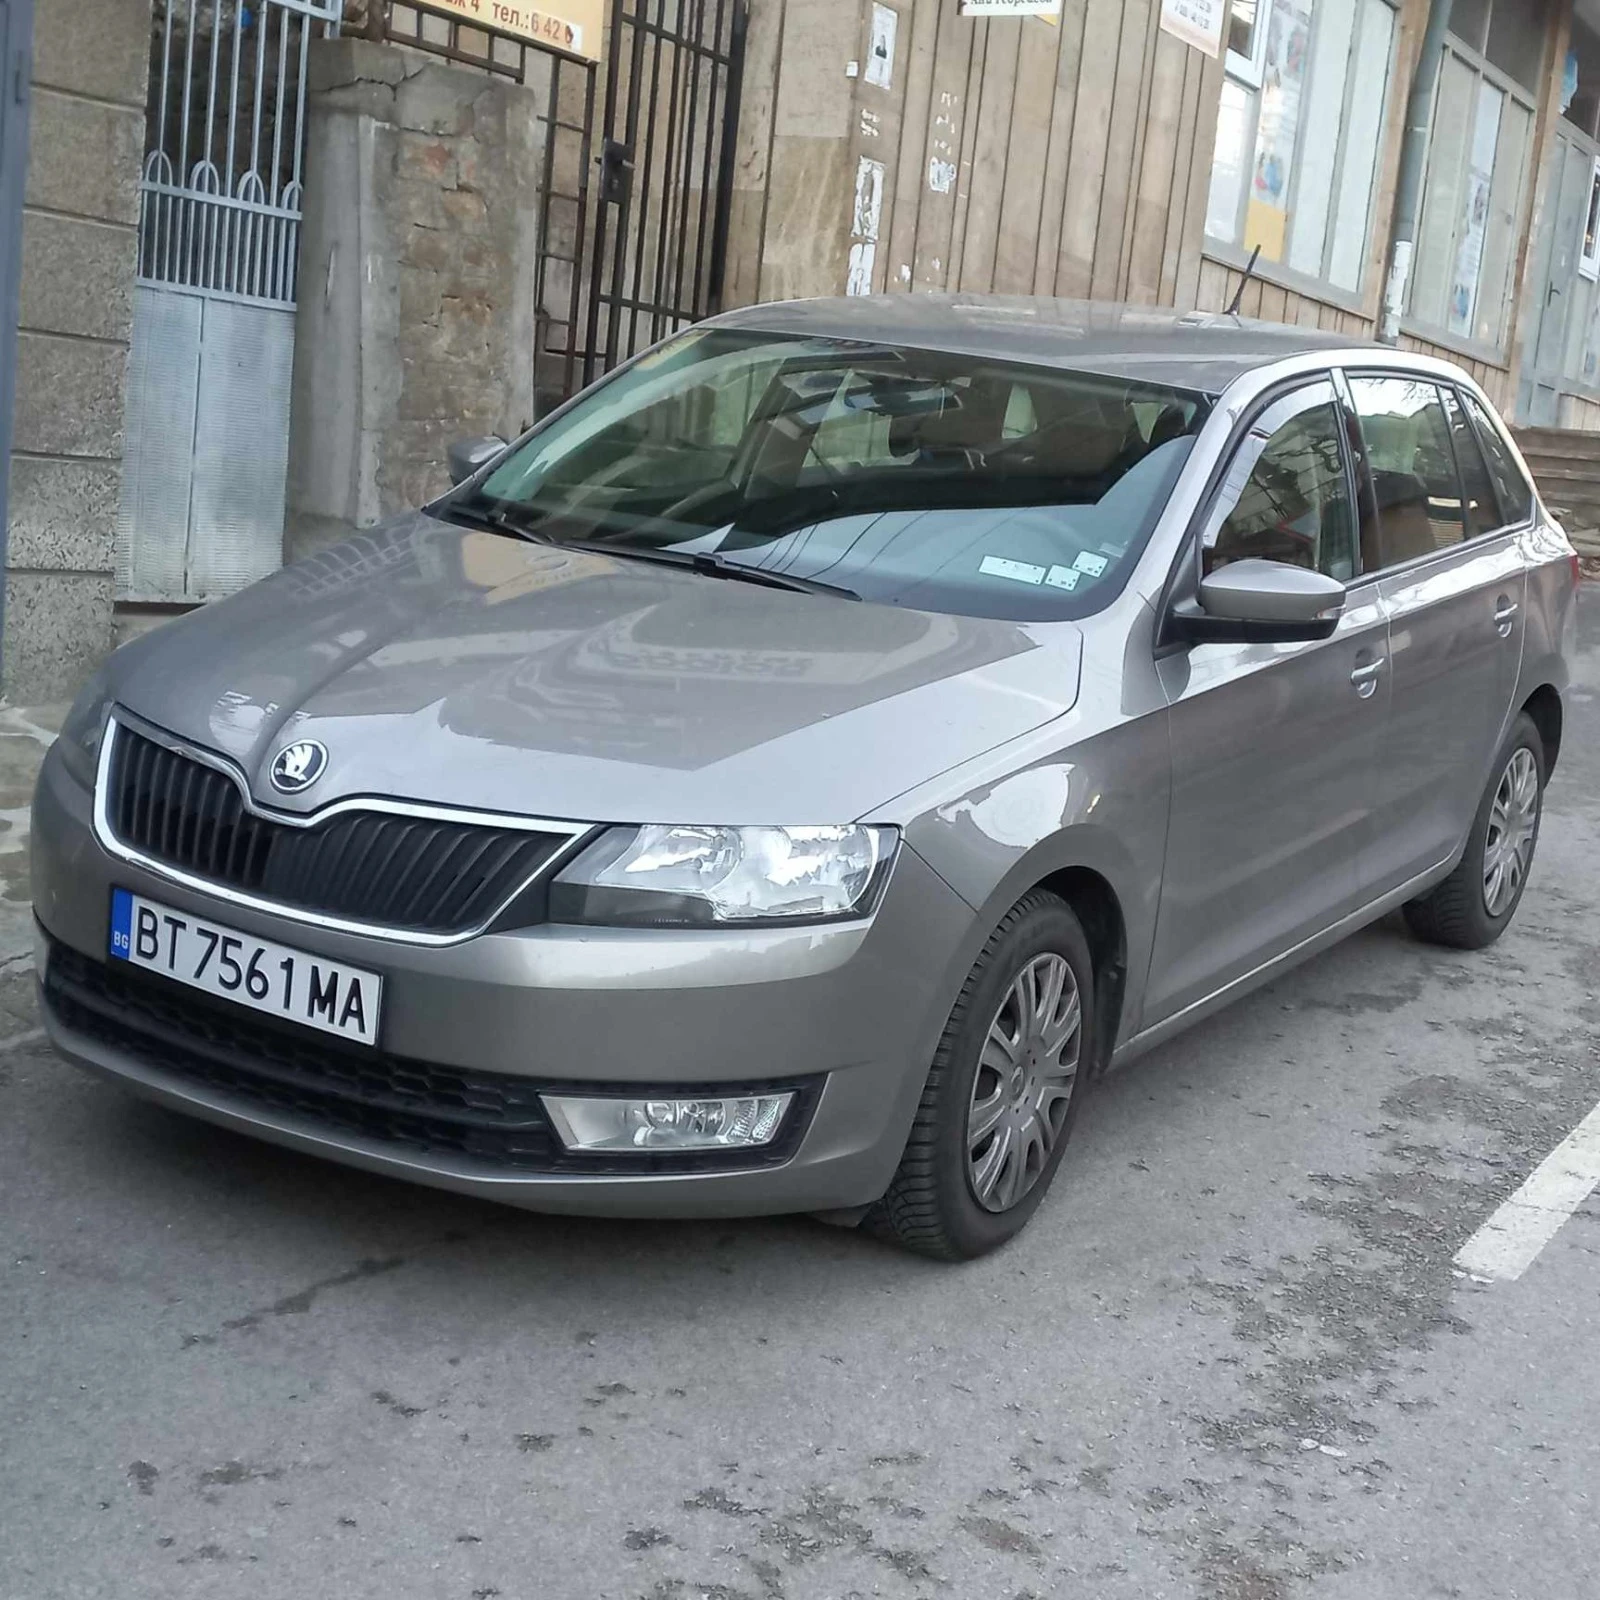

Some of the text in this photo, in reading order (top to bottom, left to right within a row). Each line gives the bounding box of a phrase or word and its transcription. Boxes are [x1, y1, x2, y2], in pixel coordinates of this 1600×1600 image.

[544, 17, 561, 40] 42
[113, 930, 129, 950] BG
[135, 906, 366, 1034] BT 7561 MA
